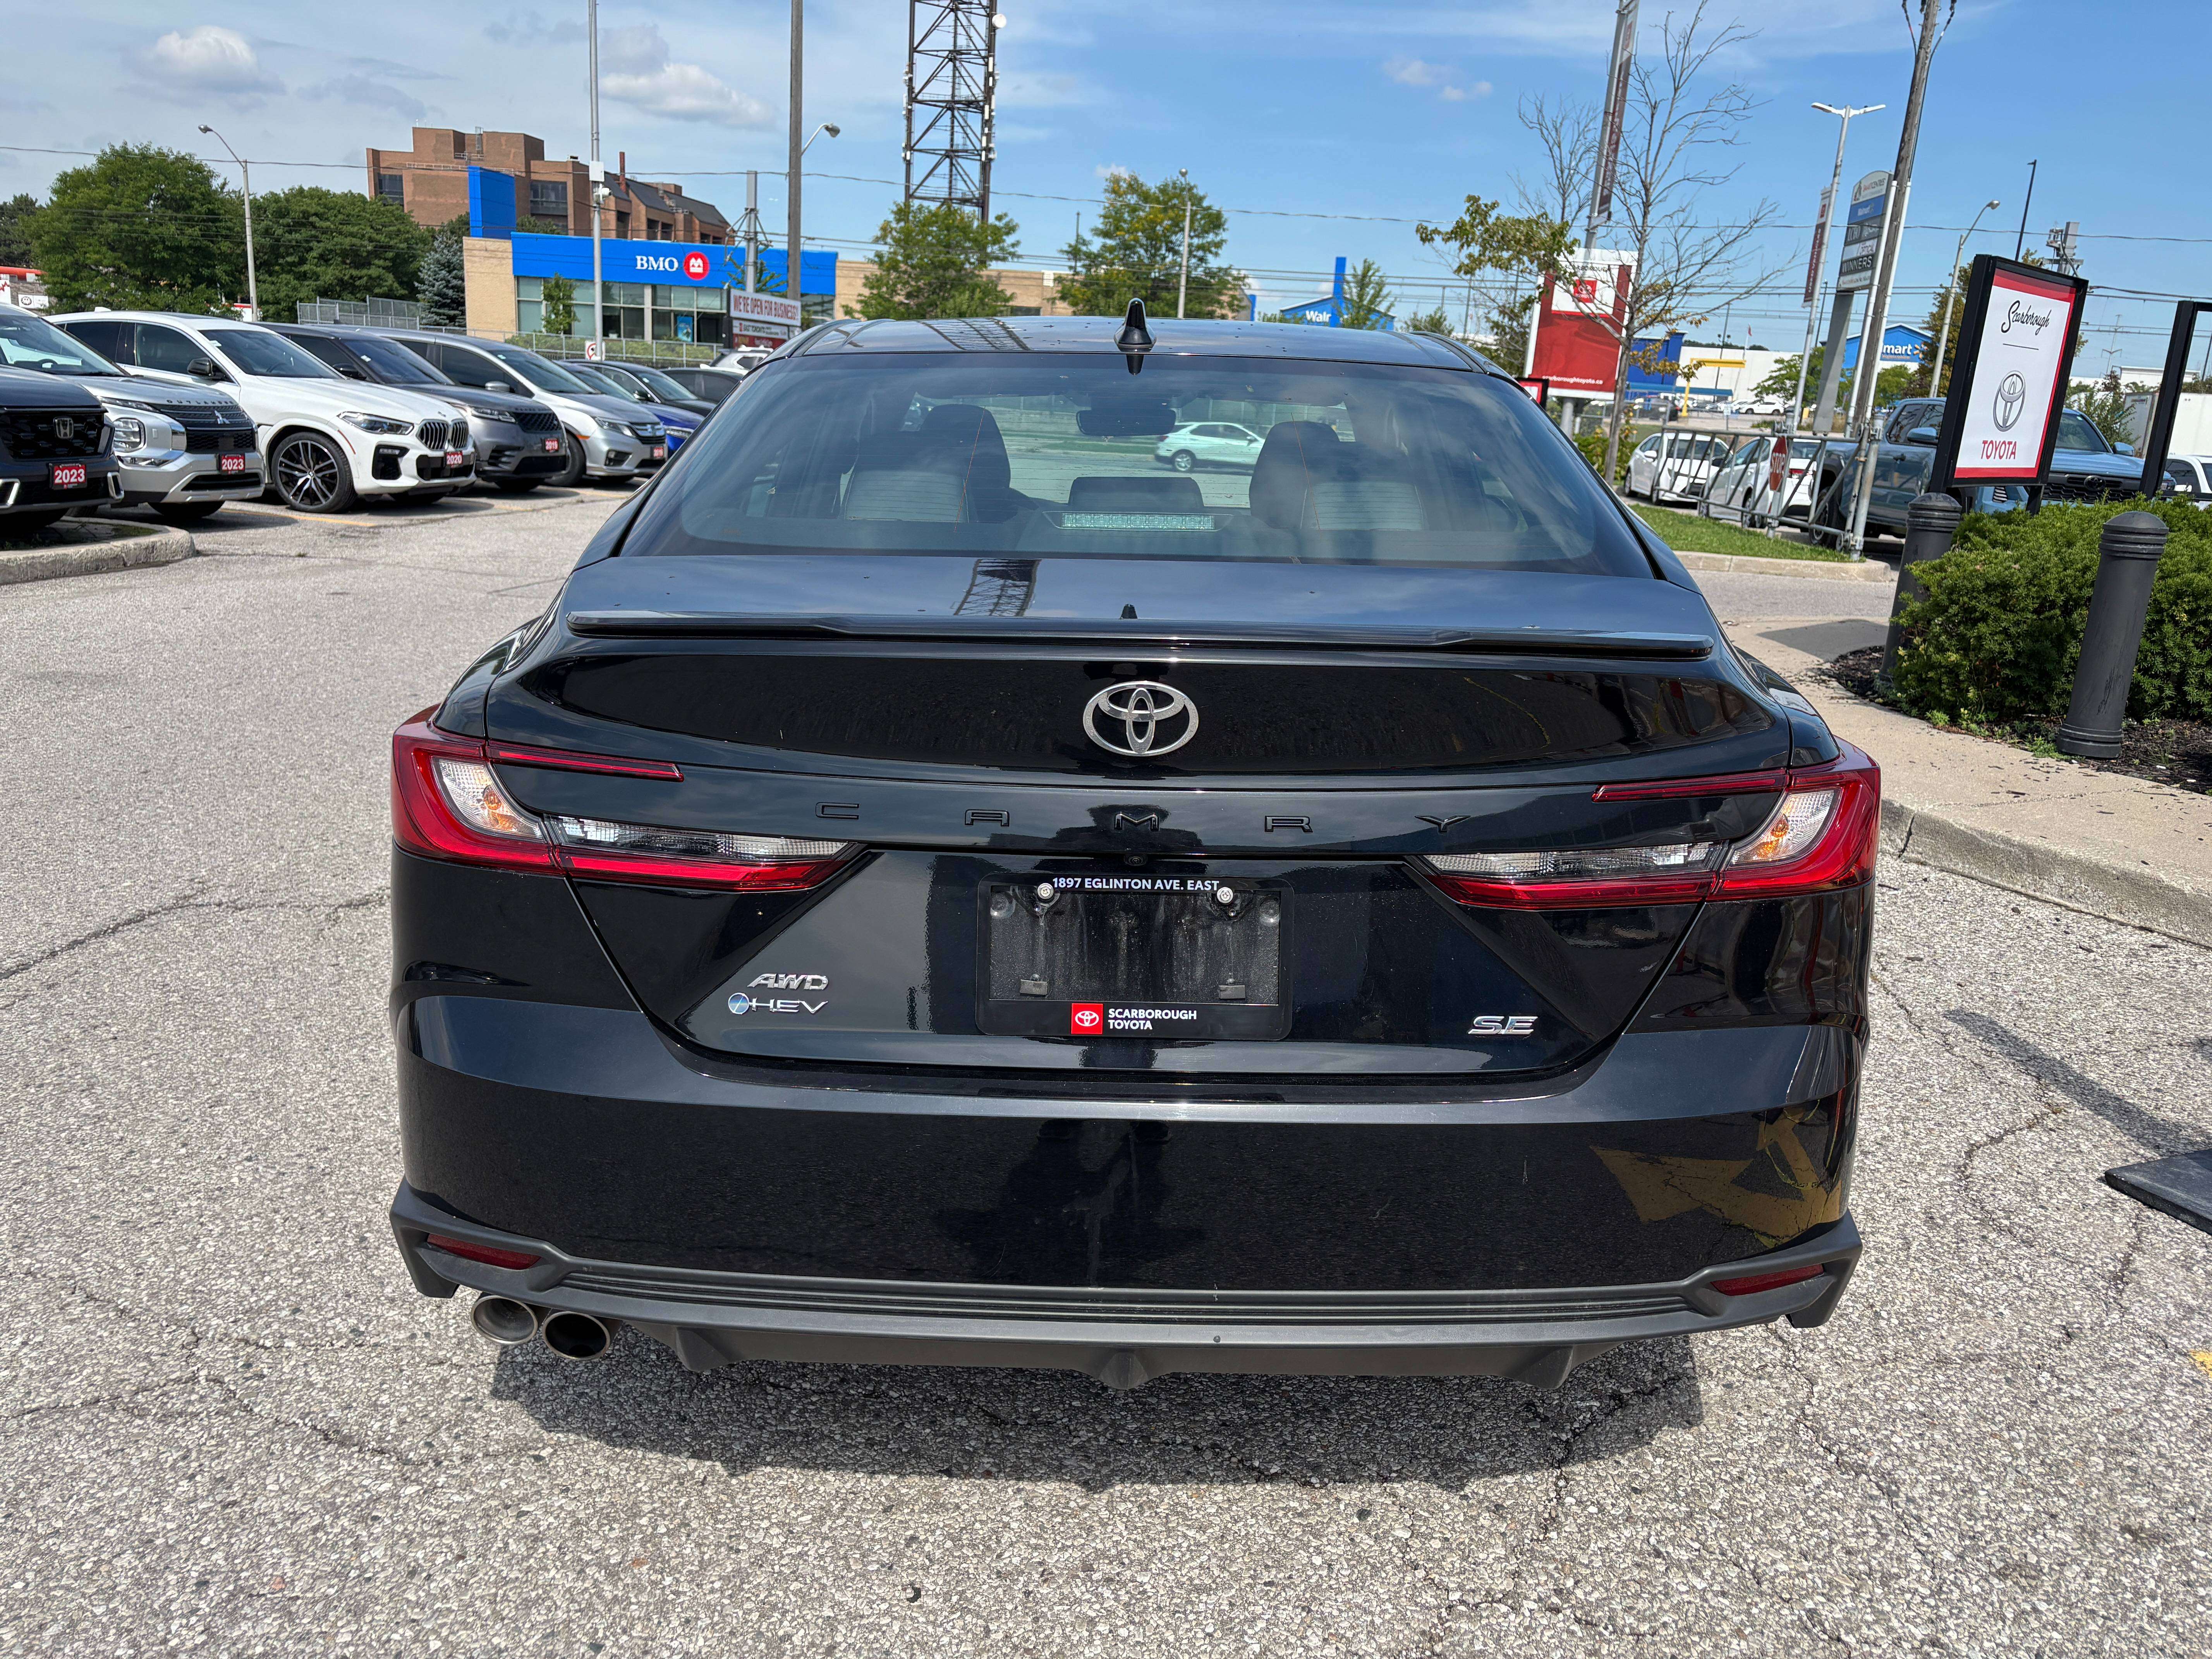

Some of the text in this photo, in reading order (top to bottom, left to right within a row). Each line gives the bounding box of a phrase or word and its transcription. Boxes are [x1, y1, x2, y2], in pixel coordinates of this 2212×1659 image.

[635, 256, 678, 271] BMO
[1842, 256, 1872, 273] WINNERS
[750, 298, 764, 316] OPEN
[764, 300, 773, 316] FOR
[2001, 300, 2051, 335] Scarborough
[1883, 344, 1912, 355] mart
[1981, 440, 2016, 459] TOYOTA
[222, 459, 244, 471] 2023
[447, 454, 462, 465] 2020
[1770, 452, 1785, 474] STOP
[55, 469, 85, 483] 2023
[816, 802, 1471, 833] CAMRY
[1053, 877, 1219, 891] 1897 EGLINTON AVE. EAST
[747, 973, 829, 990] AWD
[750, 997, 828, 1013] HEV
[1108, 1008, 1197, 1020] SCARBOROUGH
[1108, 1020, 1153, 1030] TOYOTA
[1468, 1016, 1538, 1035] SE
